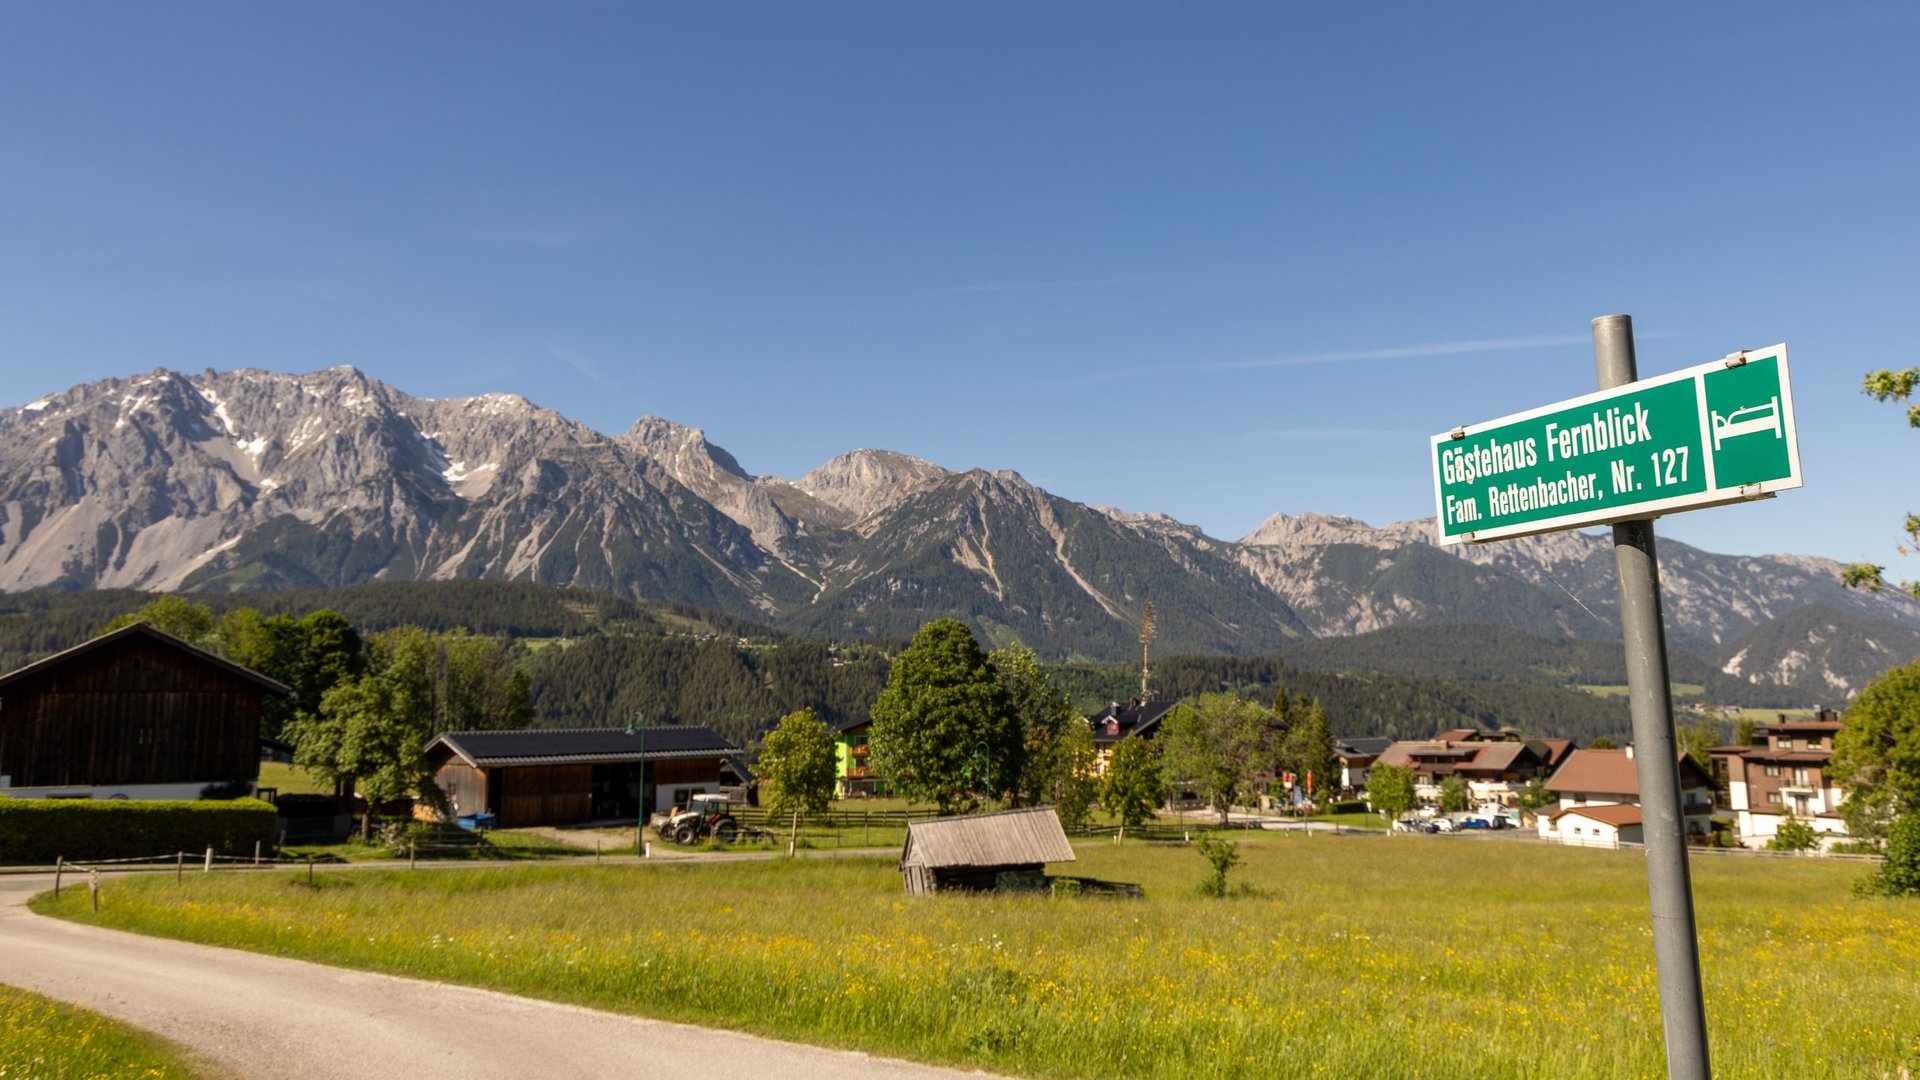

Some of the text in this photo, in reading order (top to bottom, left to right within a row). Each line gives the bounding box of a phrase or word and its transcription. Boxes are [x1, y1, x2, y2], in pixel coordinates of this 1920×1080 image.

[1442, 401, 1652, 485] Gästehaus Fernblick
[1446, 445, 1689, 525] Fam. Rettenbacher, Nr. 127
